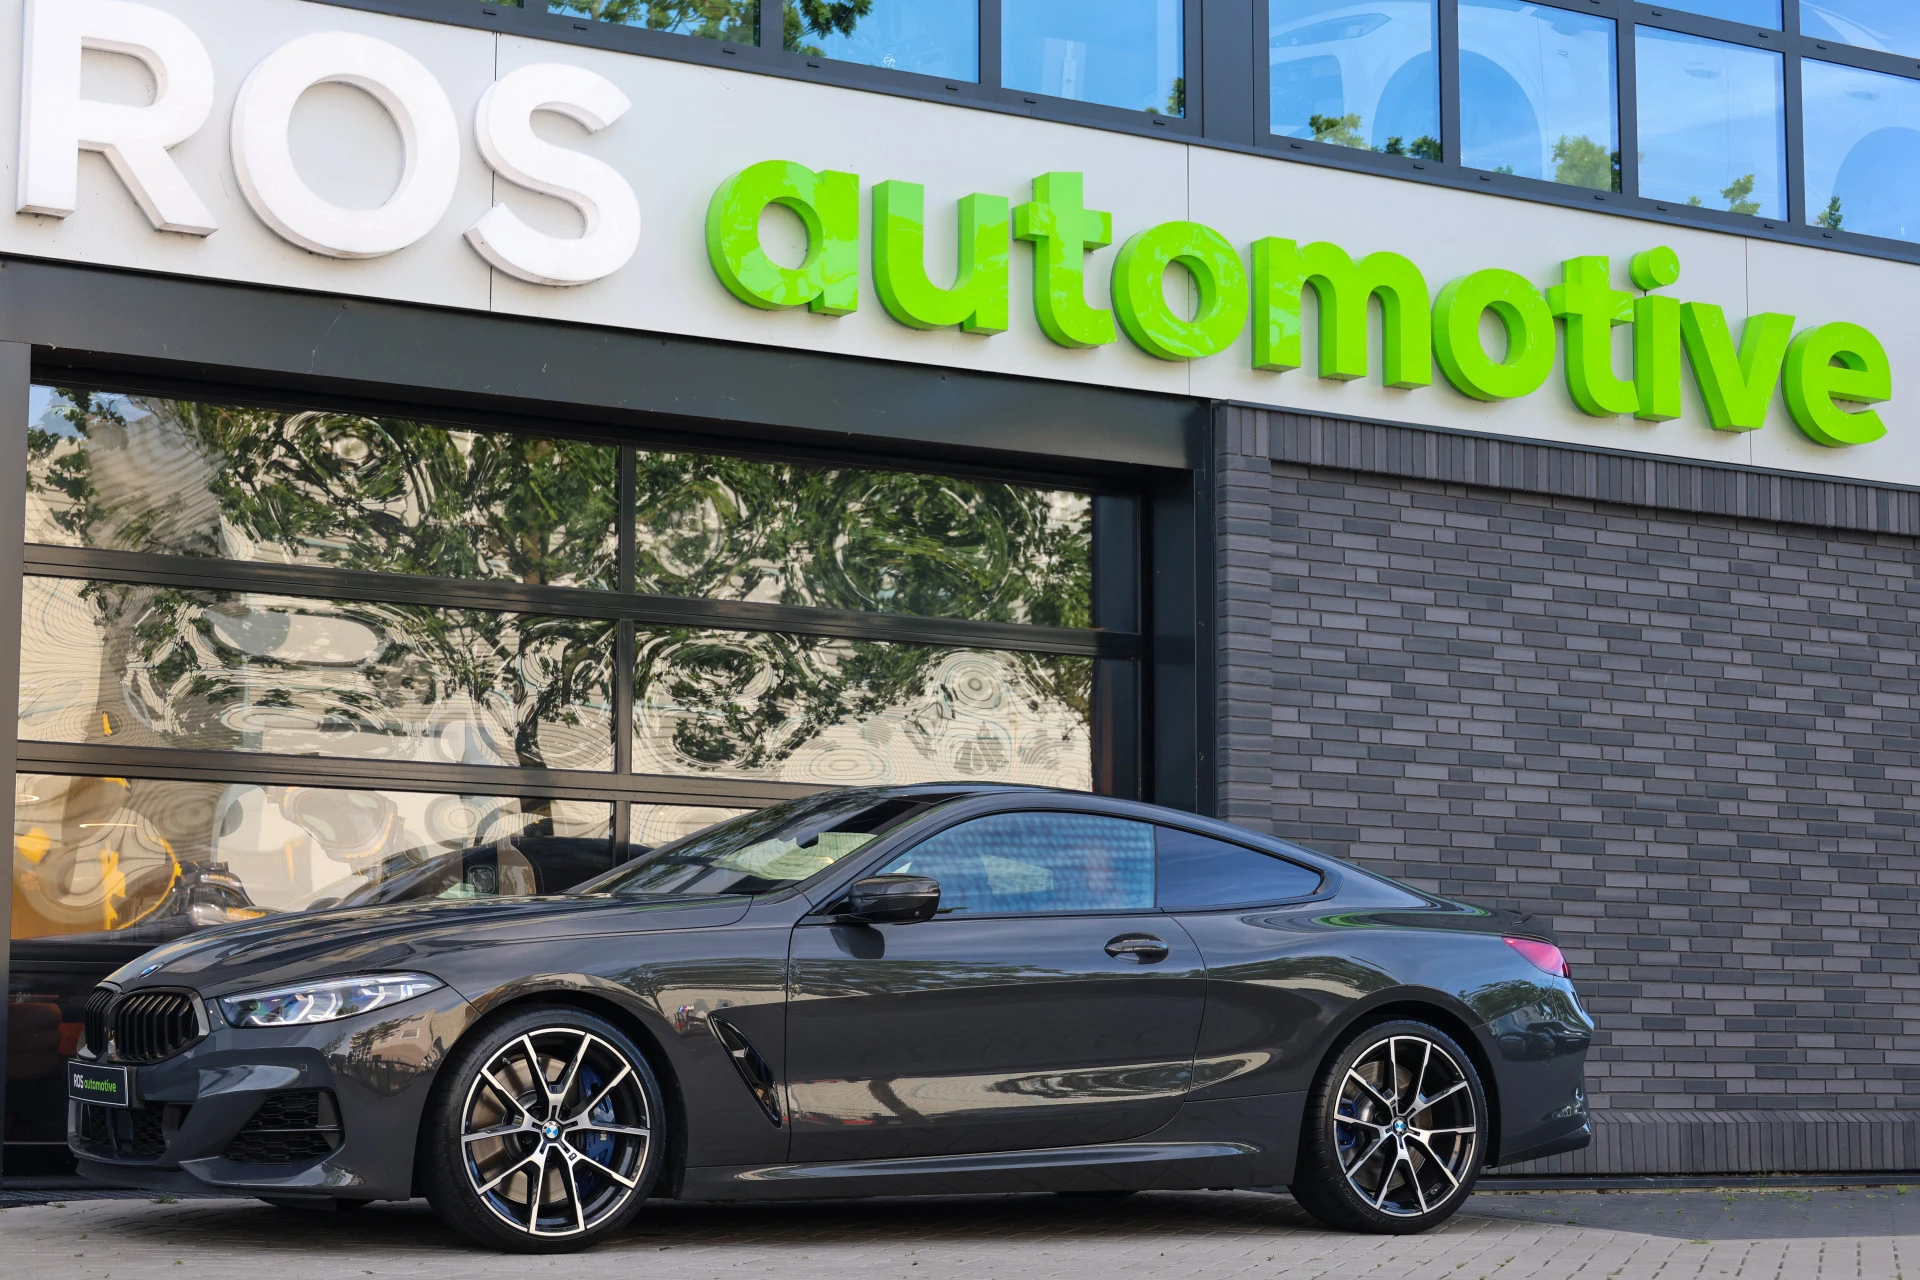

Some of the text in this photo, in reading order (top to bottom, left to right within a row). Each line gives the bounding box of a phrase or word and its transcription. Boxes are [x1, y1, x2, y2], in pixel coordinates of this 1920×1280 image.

[17, 0, 1892, 448] ROS automotive
[73, 1073, 117, 1093] ROS automotive
